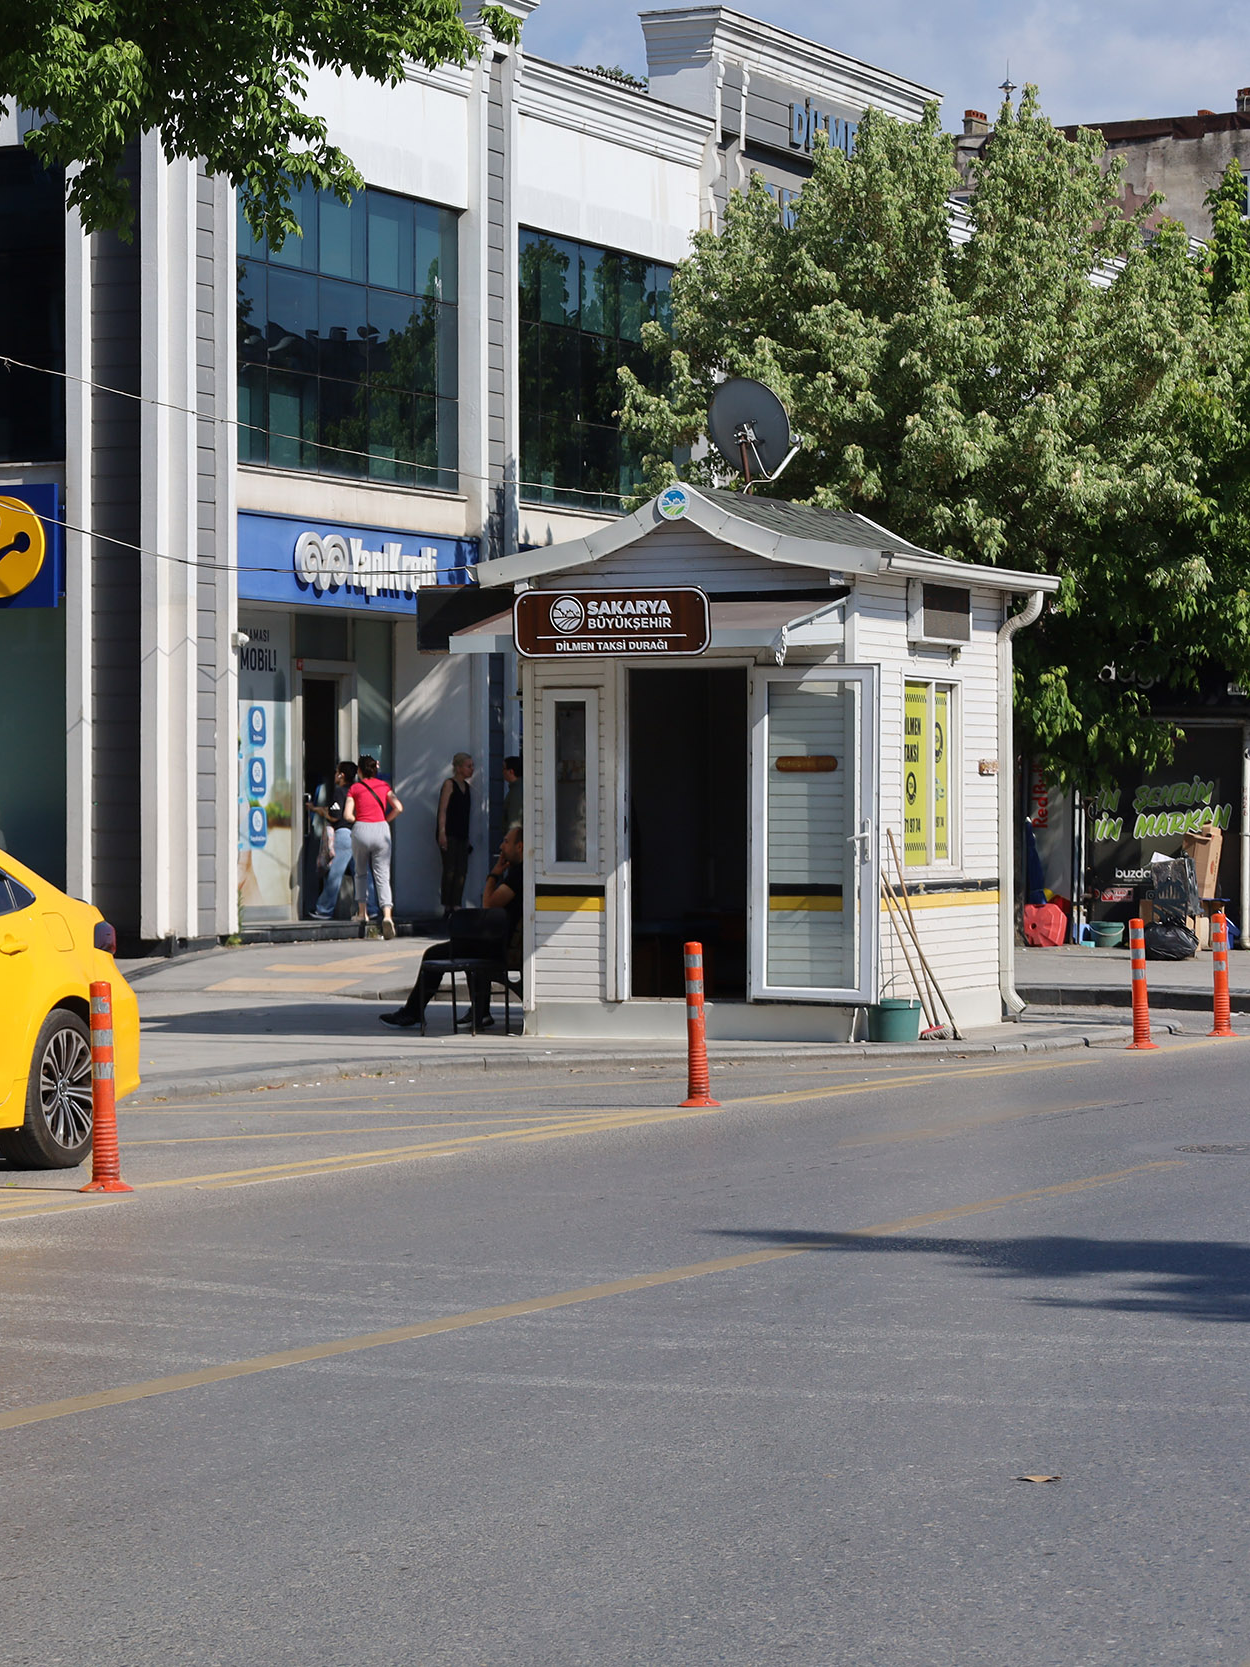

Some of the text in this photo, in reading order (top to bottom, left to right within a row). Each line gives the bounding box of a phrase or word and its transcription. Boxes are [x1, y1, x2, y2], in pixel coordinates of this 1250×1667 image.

[587, 600, 672, 615] SAKARYA
[556, 639, 668, 652] DİLMEN TAKSİ DURAĞI
